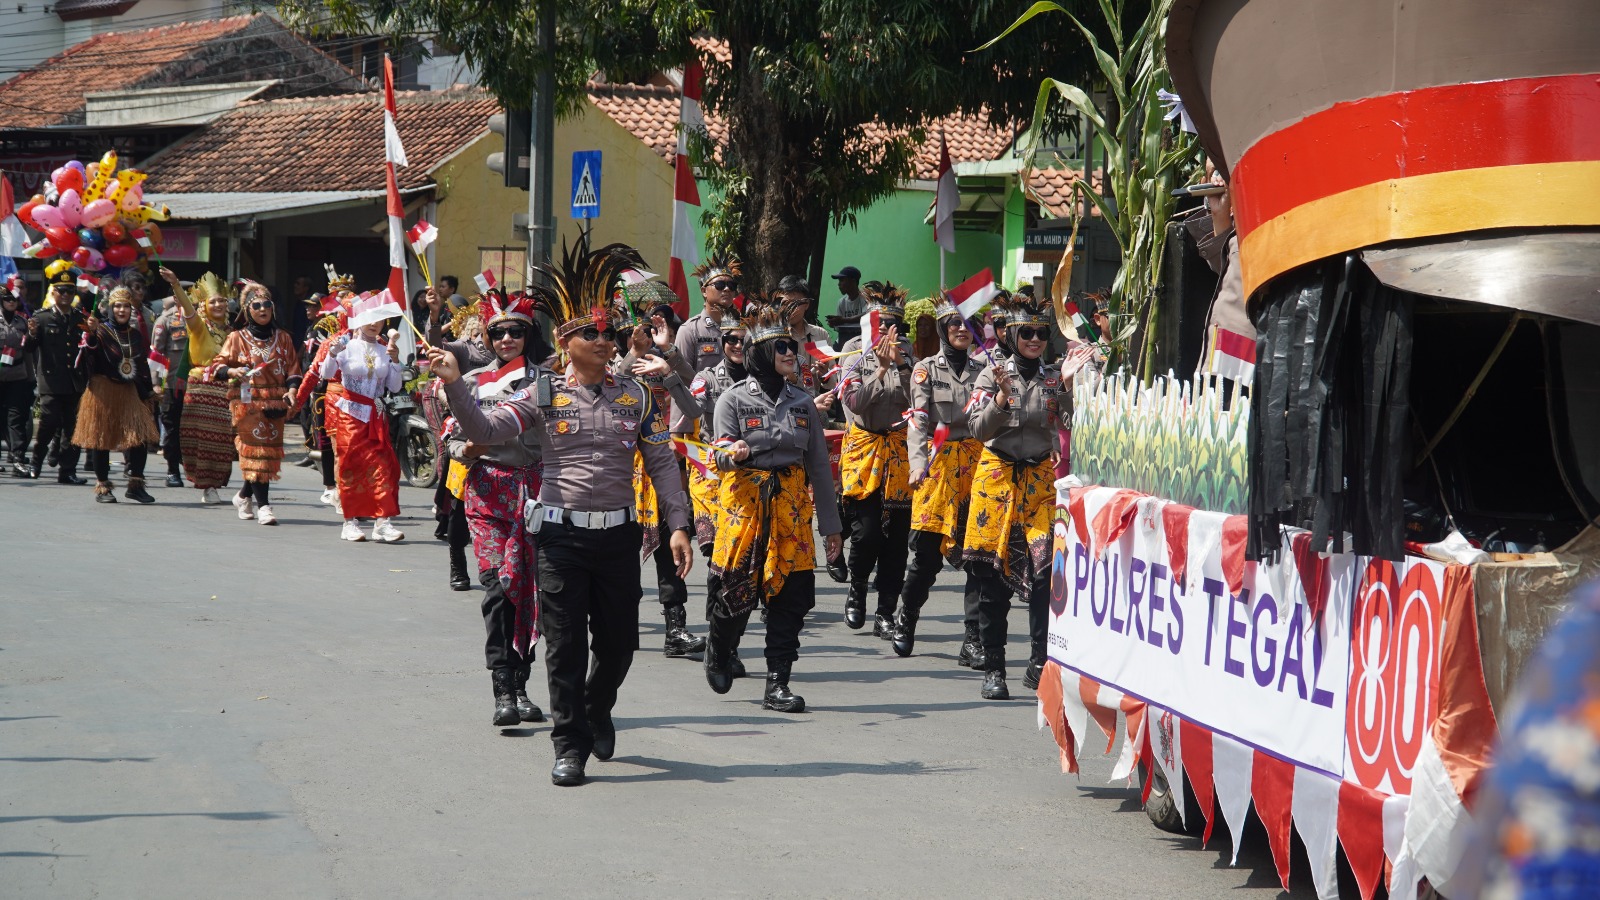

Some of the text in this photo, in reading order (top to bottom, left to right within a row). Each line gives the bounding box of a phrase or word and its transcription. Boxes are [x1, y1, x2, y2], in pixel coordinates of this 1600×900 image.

[544, 409, 579, 419] HENRY
[1073, 542, 1334, 709] POLRES TEGAL
[1348, 557, 1443, 794] 80
